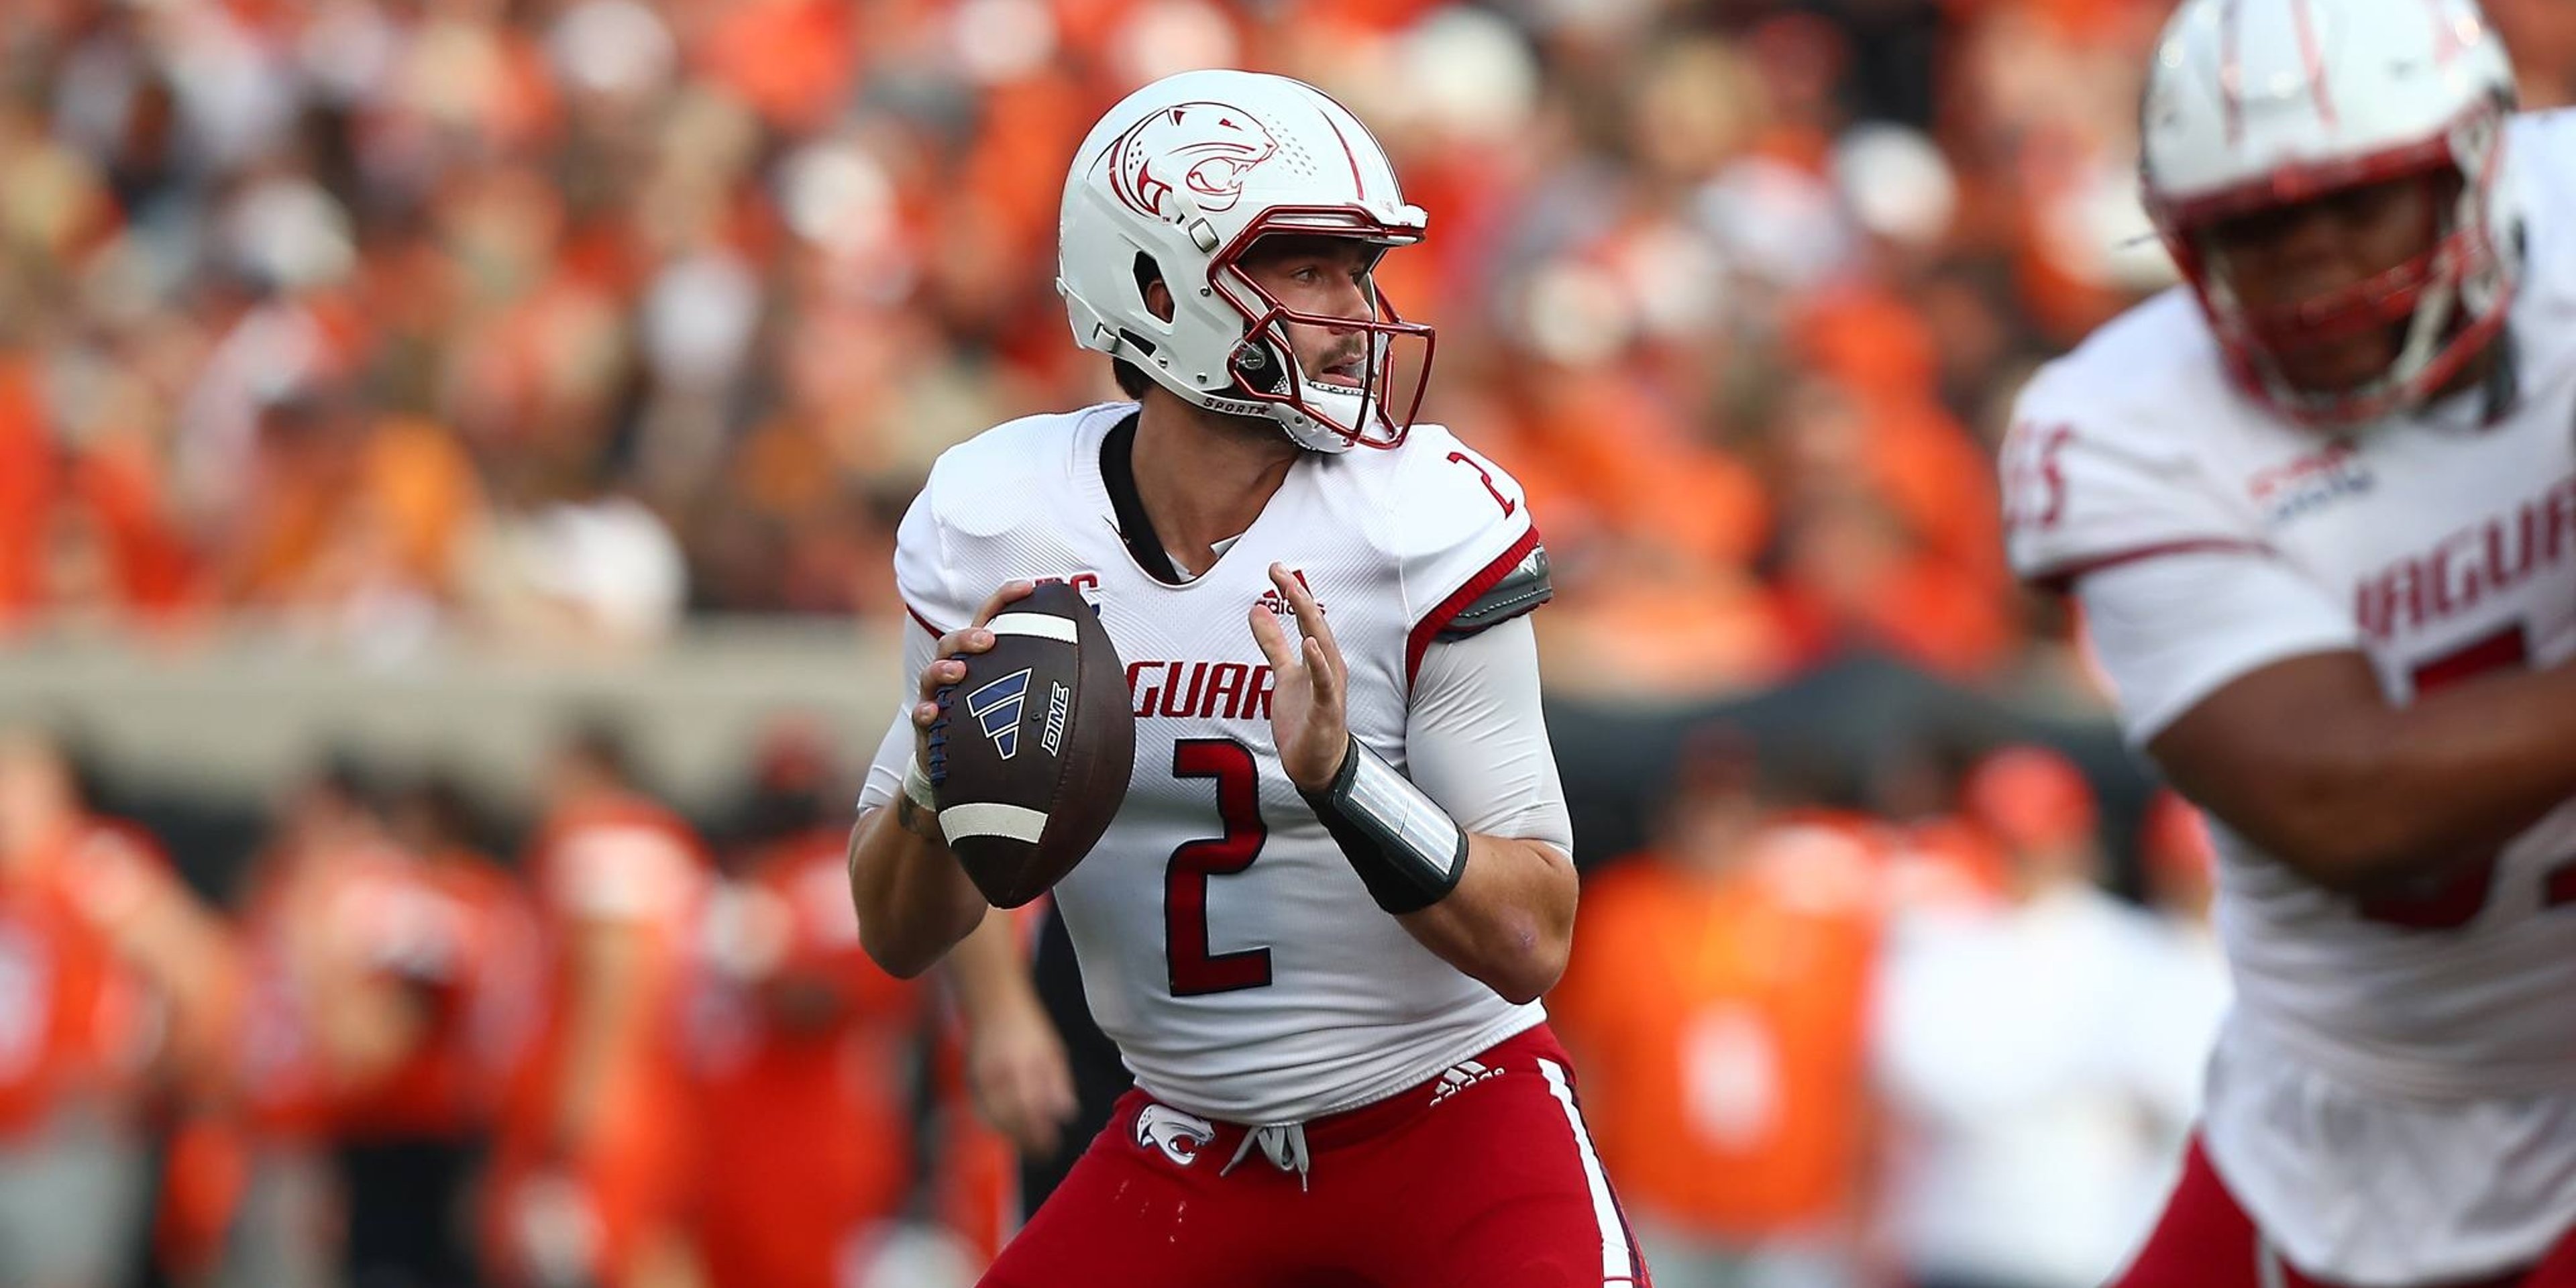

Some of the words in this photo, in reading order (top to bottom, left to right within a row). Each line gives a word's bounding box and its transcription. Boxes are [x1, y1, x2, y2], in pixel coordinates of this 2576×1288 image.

[1446, 451, 1515, 520] 2
[1041, 680, 1070, 757] DIME
[1126, 661, 1275, 720] GUAR
[1164, 738, 1272, 997] 2
